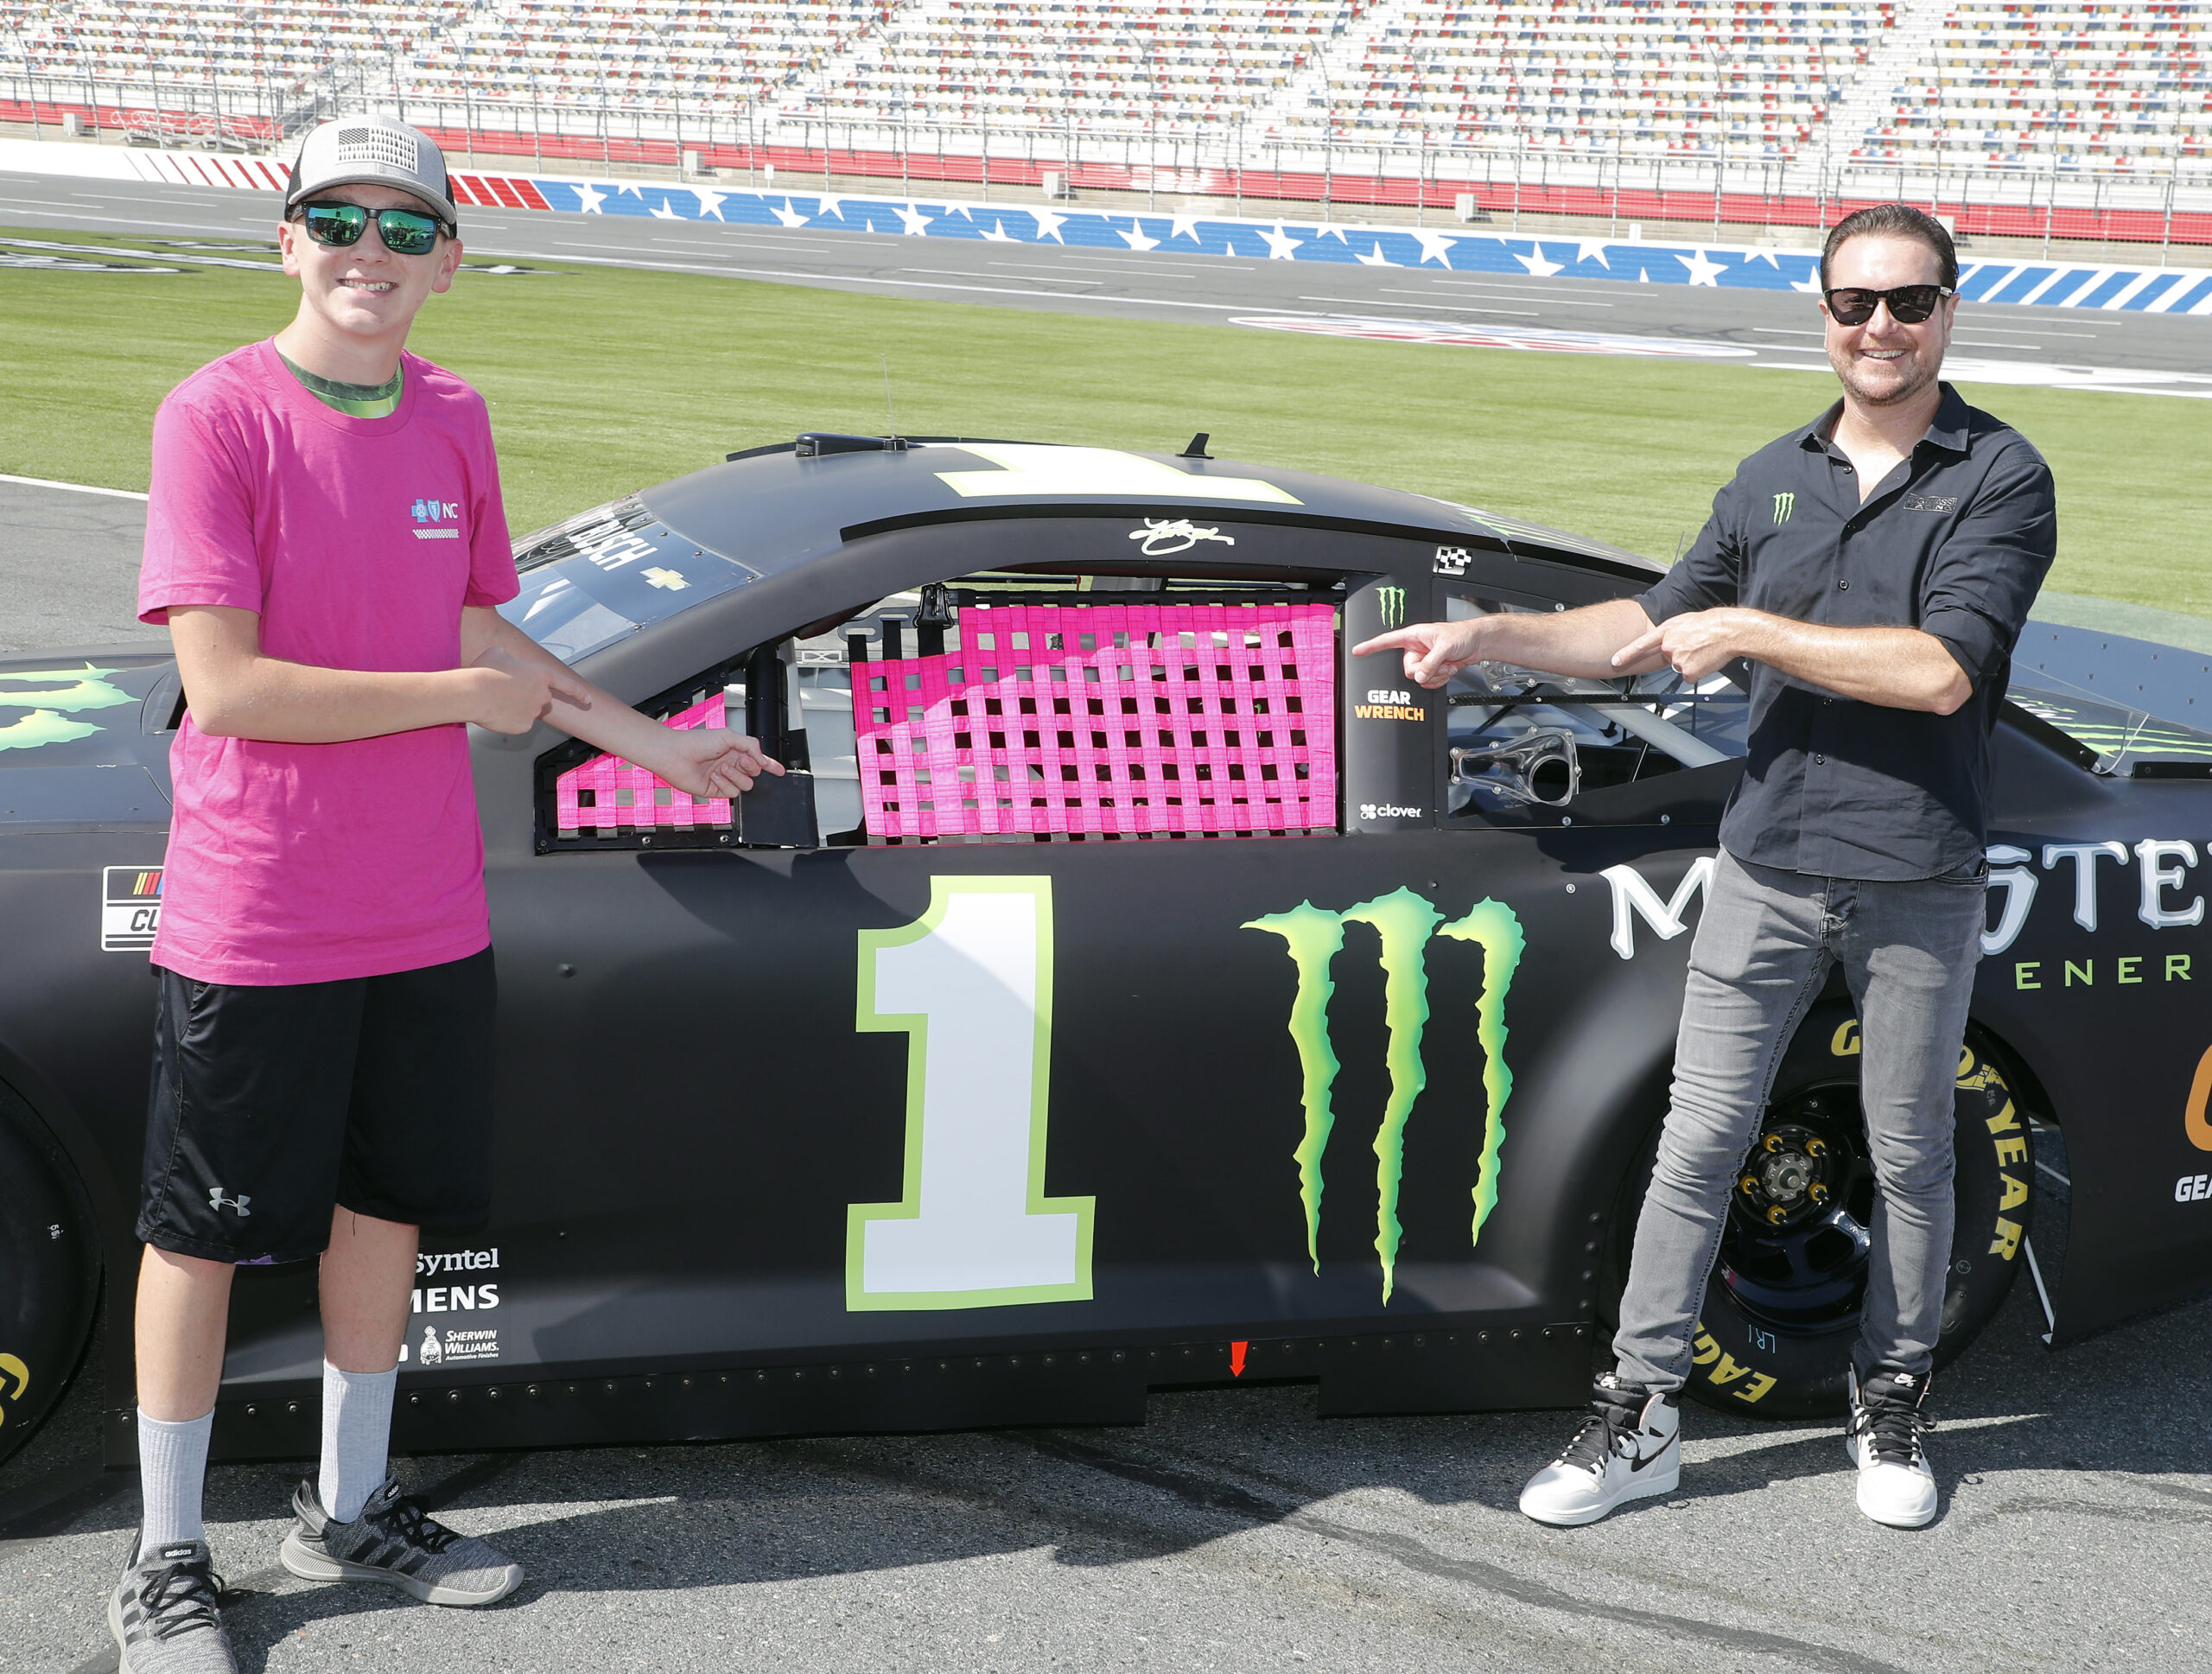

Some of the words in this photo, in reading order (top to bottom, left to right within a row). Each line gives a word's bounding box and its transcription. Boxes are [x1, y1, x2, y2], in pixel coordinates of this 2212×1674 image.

[442, 502, 459, 519] NC
[565, 519, 658, 571] BUSCH
[1367, 690, 1411, 705] GEAR
[1354, 704, 1425, 722] WRENCH
[1376, 803, 1422, 818] clover
[2015, 953, 2192, 990] ENER
[846, 875, 1096, 1313] 1
[1692, 1321, 1777, 1403] EAG
[164, 1548, 192, 1557] adidas
